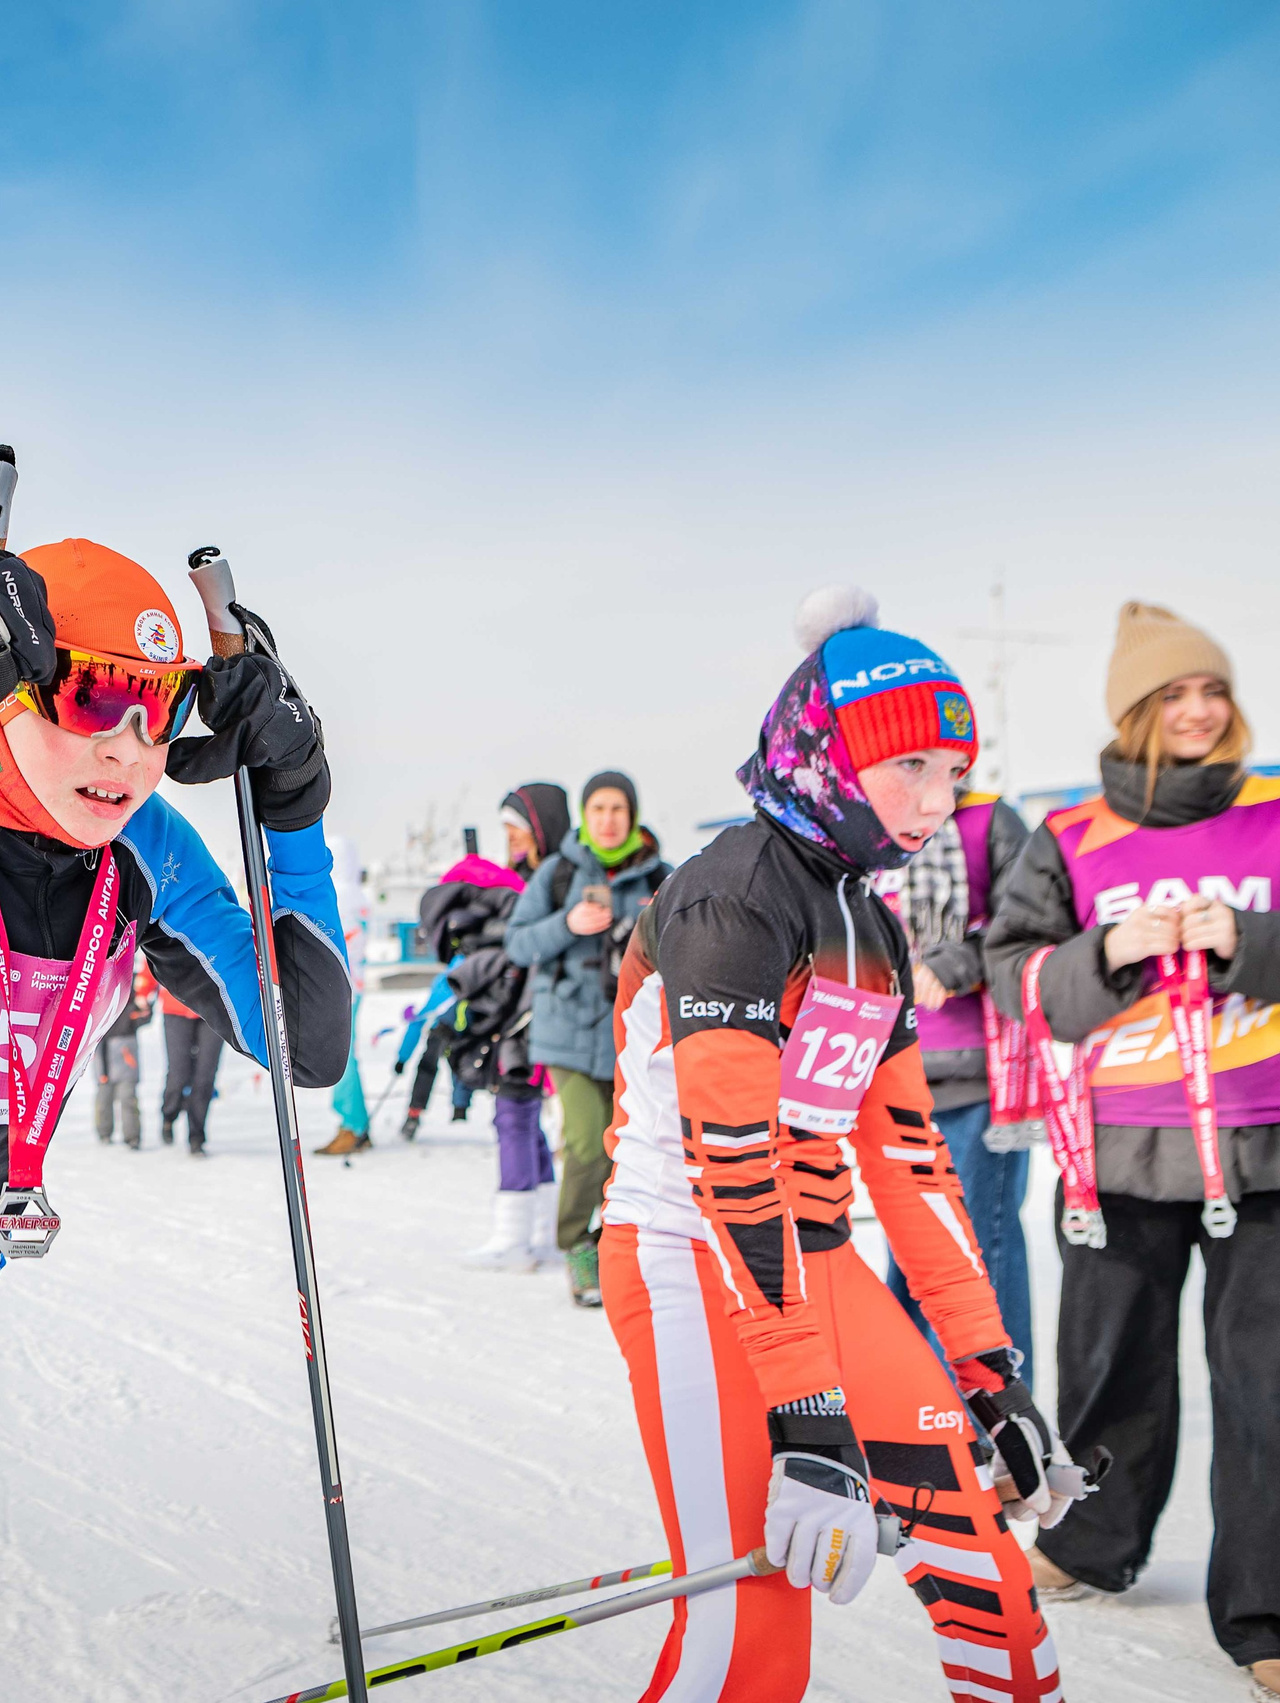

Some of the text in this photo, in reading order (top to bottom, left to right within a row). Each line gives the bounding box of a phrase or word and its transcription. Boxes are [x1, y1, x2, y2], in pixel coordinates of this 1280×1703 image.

[69, 856, 116, 1013] ТЕМЕРСО АНГАРА
[680, 995, 775, 1023] Easy ski
[48, 1053, 61, 1078] БАМ
[13, 1067, 27, 1123] АНГА
[25, 1082, 56, 1145] ТЕМЕРСО
[918, 1406, 964, 1434] Easy
